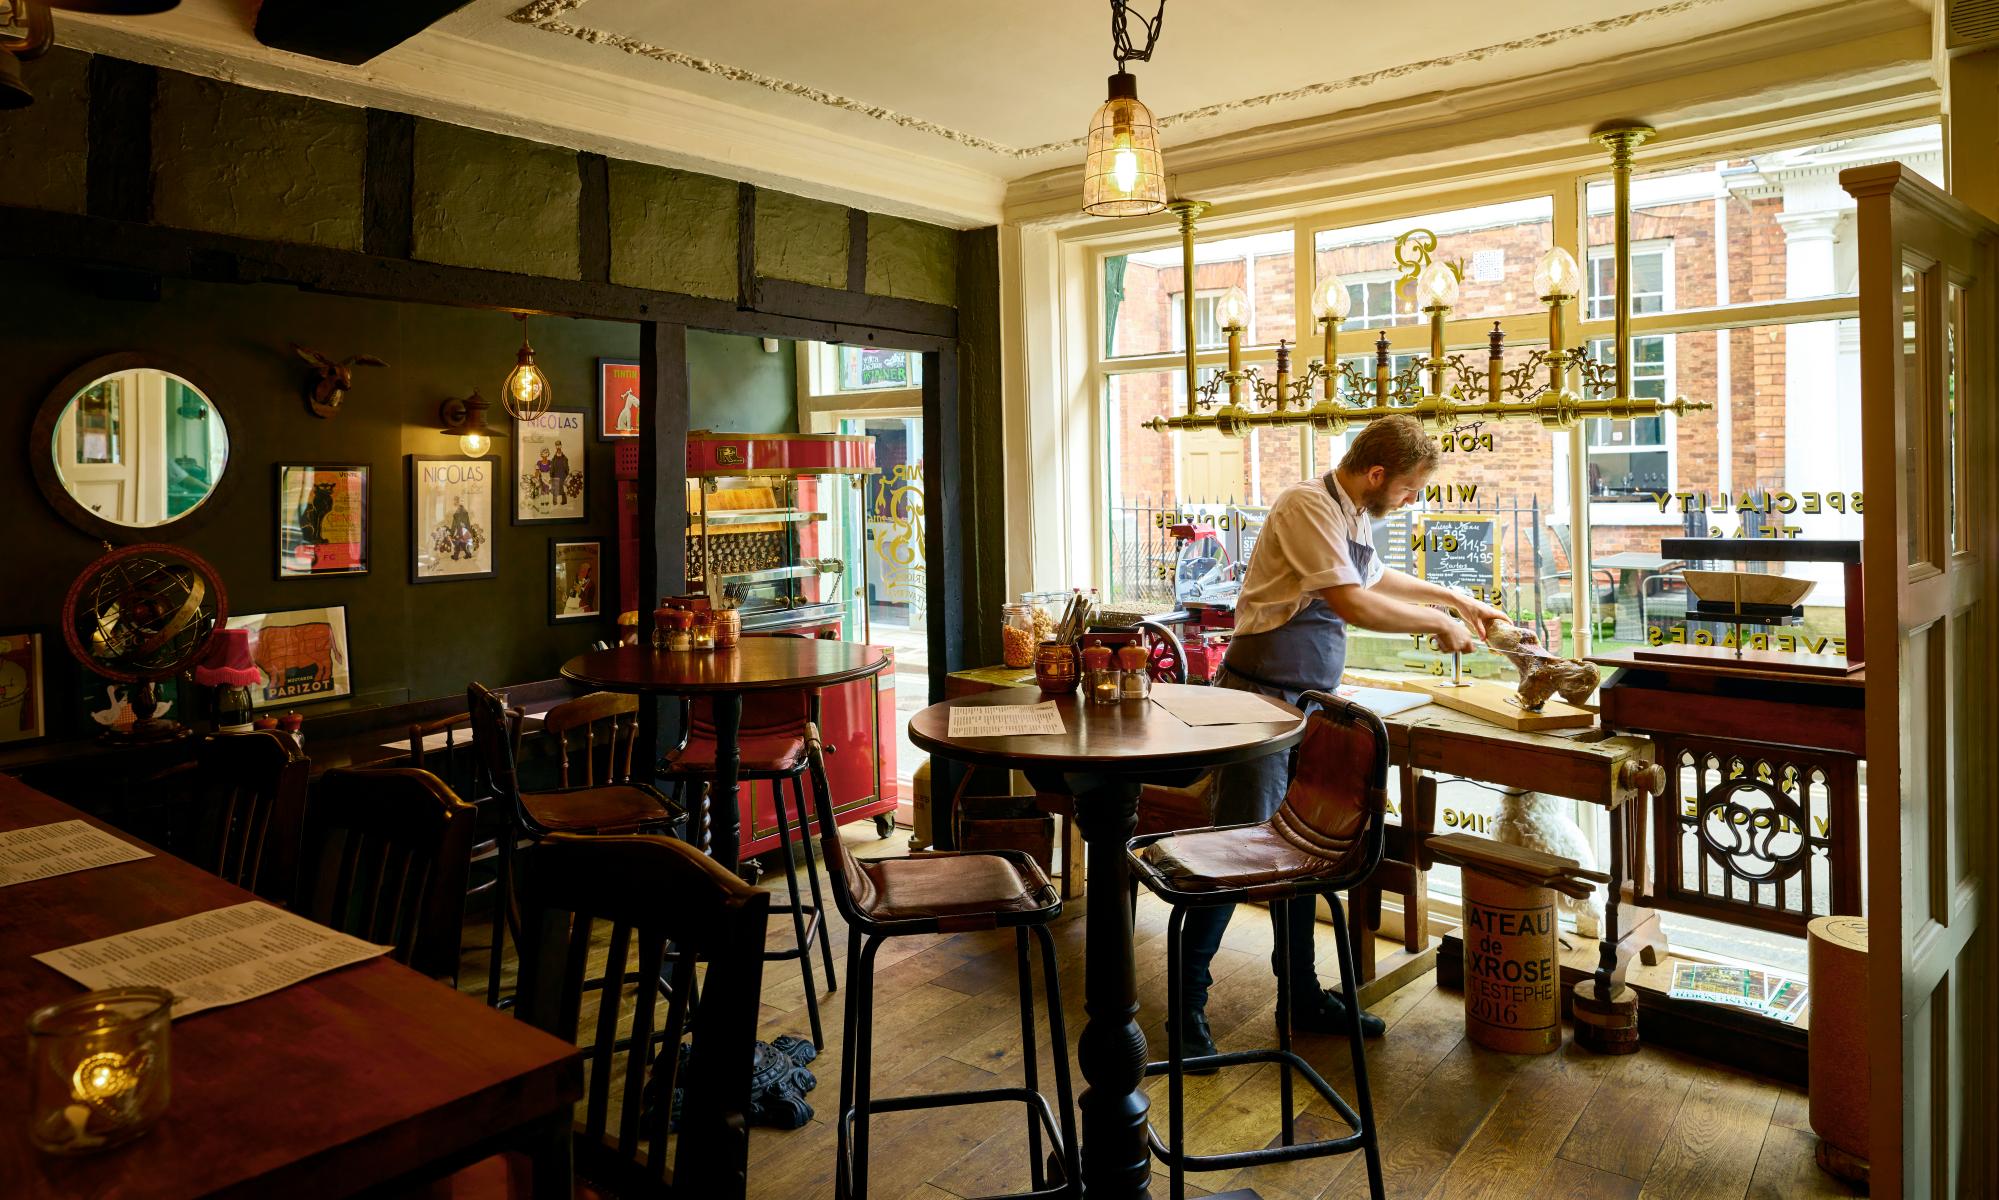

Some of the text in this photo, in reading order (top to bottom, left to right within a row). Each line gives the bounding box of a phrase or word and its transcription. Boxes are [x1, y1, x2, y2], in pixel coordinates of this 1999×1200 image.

[613, 369, 637, 379] TINTIN
[527, 414, 578, 430] NICOLAS
[424, 464, 484, 484] NICOLAS
[1438, 561, 1468, 569] Starters
[1466, 552, 1494, 564] 1495
[268, 680, 331, 699] PARIZOT
[1480, 935, 1503, 956] de
[1480, 980, 1553, 1003] ESTEPHE
[1470, 995, 1518, 1025] 2016
